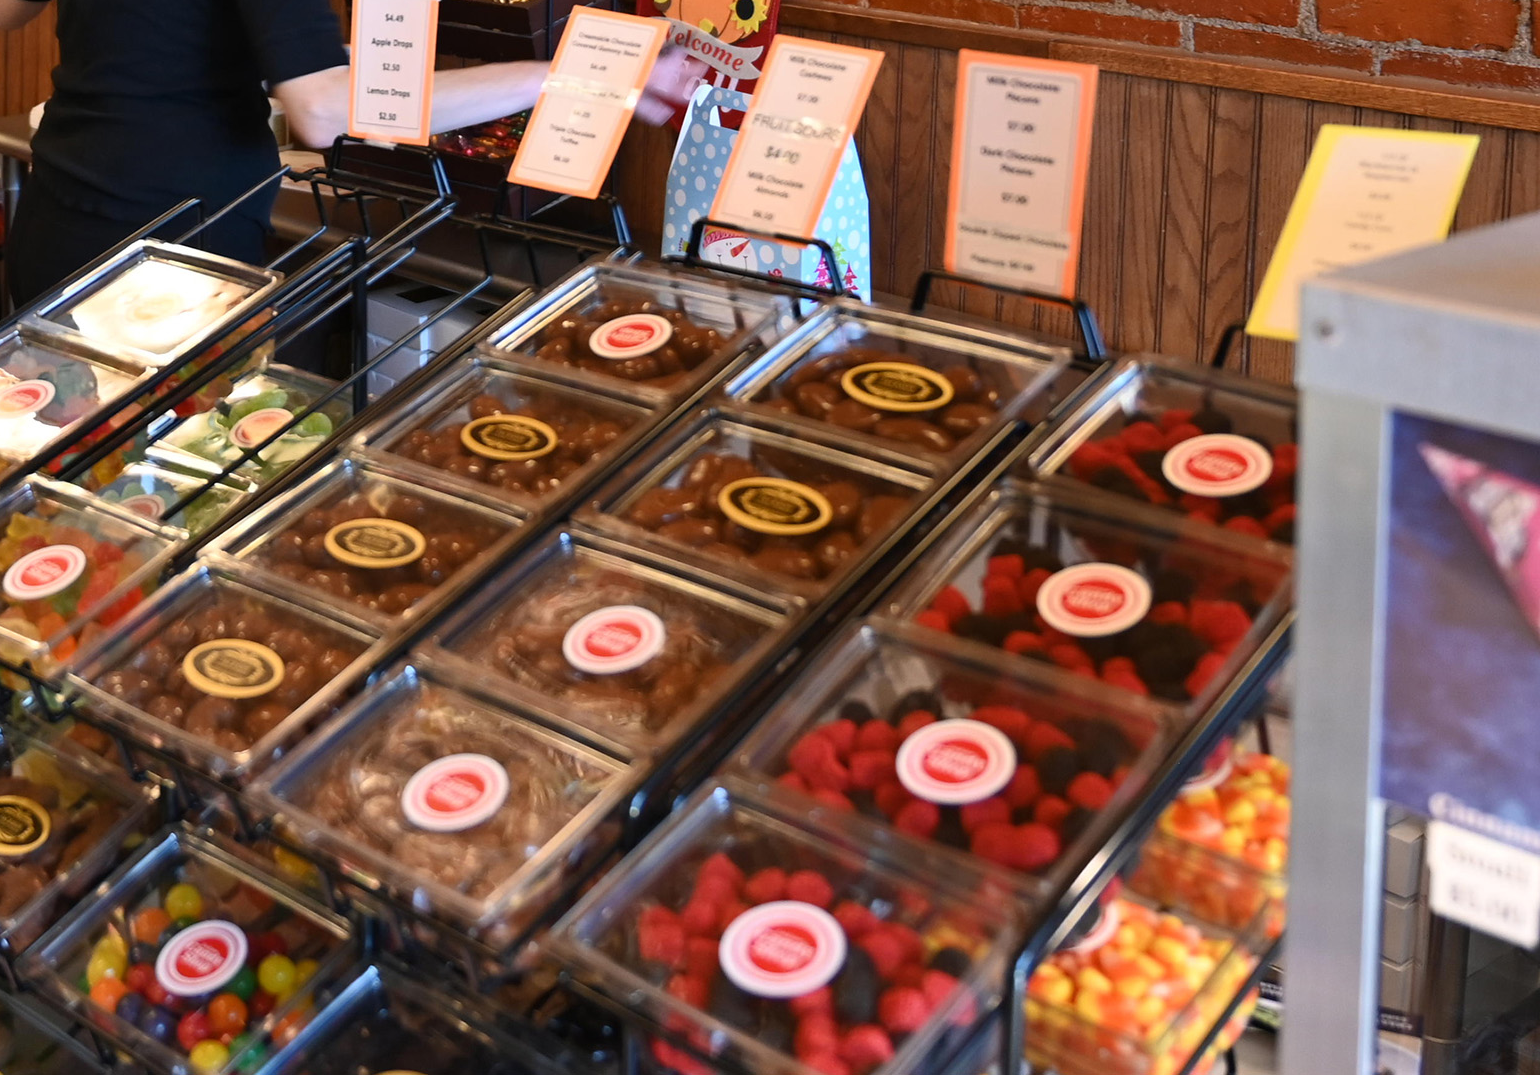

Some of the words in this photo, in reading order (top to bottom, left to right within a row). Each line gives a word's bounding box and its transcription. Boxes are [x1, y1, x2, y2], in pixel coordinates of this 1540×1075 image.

[371, 37, 391, 48] Apple
[393, 38, 413, 49] Drops
[808, 58, 846, 71] Chocolate
[367, 87, 389, 96] Lemon
[391, 88, 410, 98] Drops
[1009, 78, 1060, 93] Chocolate
[1005, 150, 1055, 165] Chocolate
[766, 174, 804, 189] Chocolate
